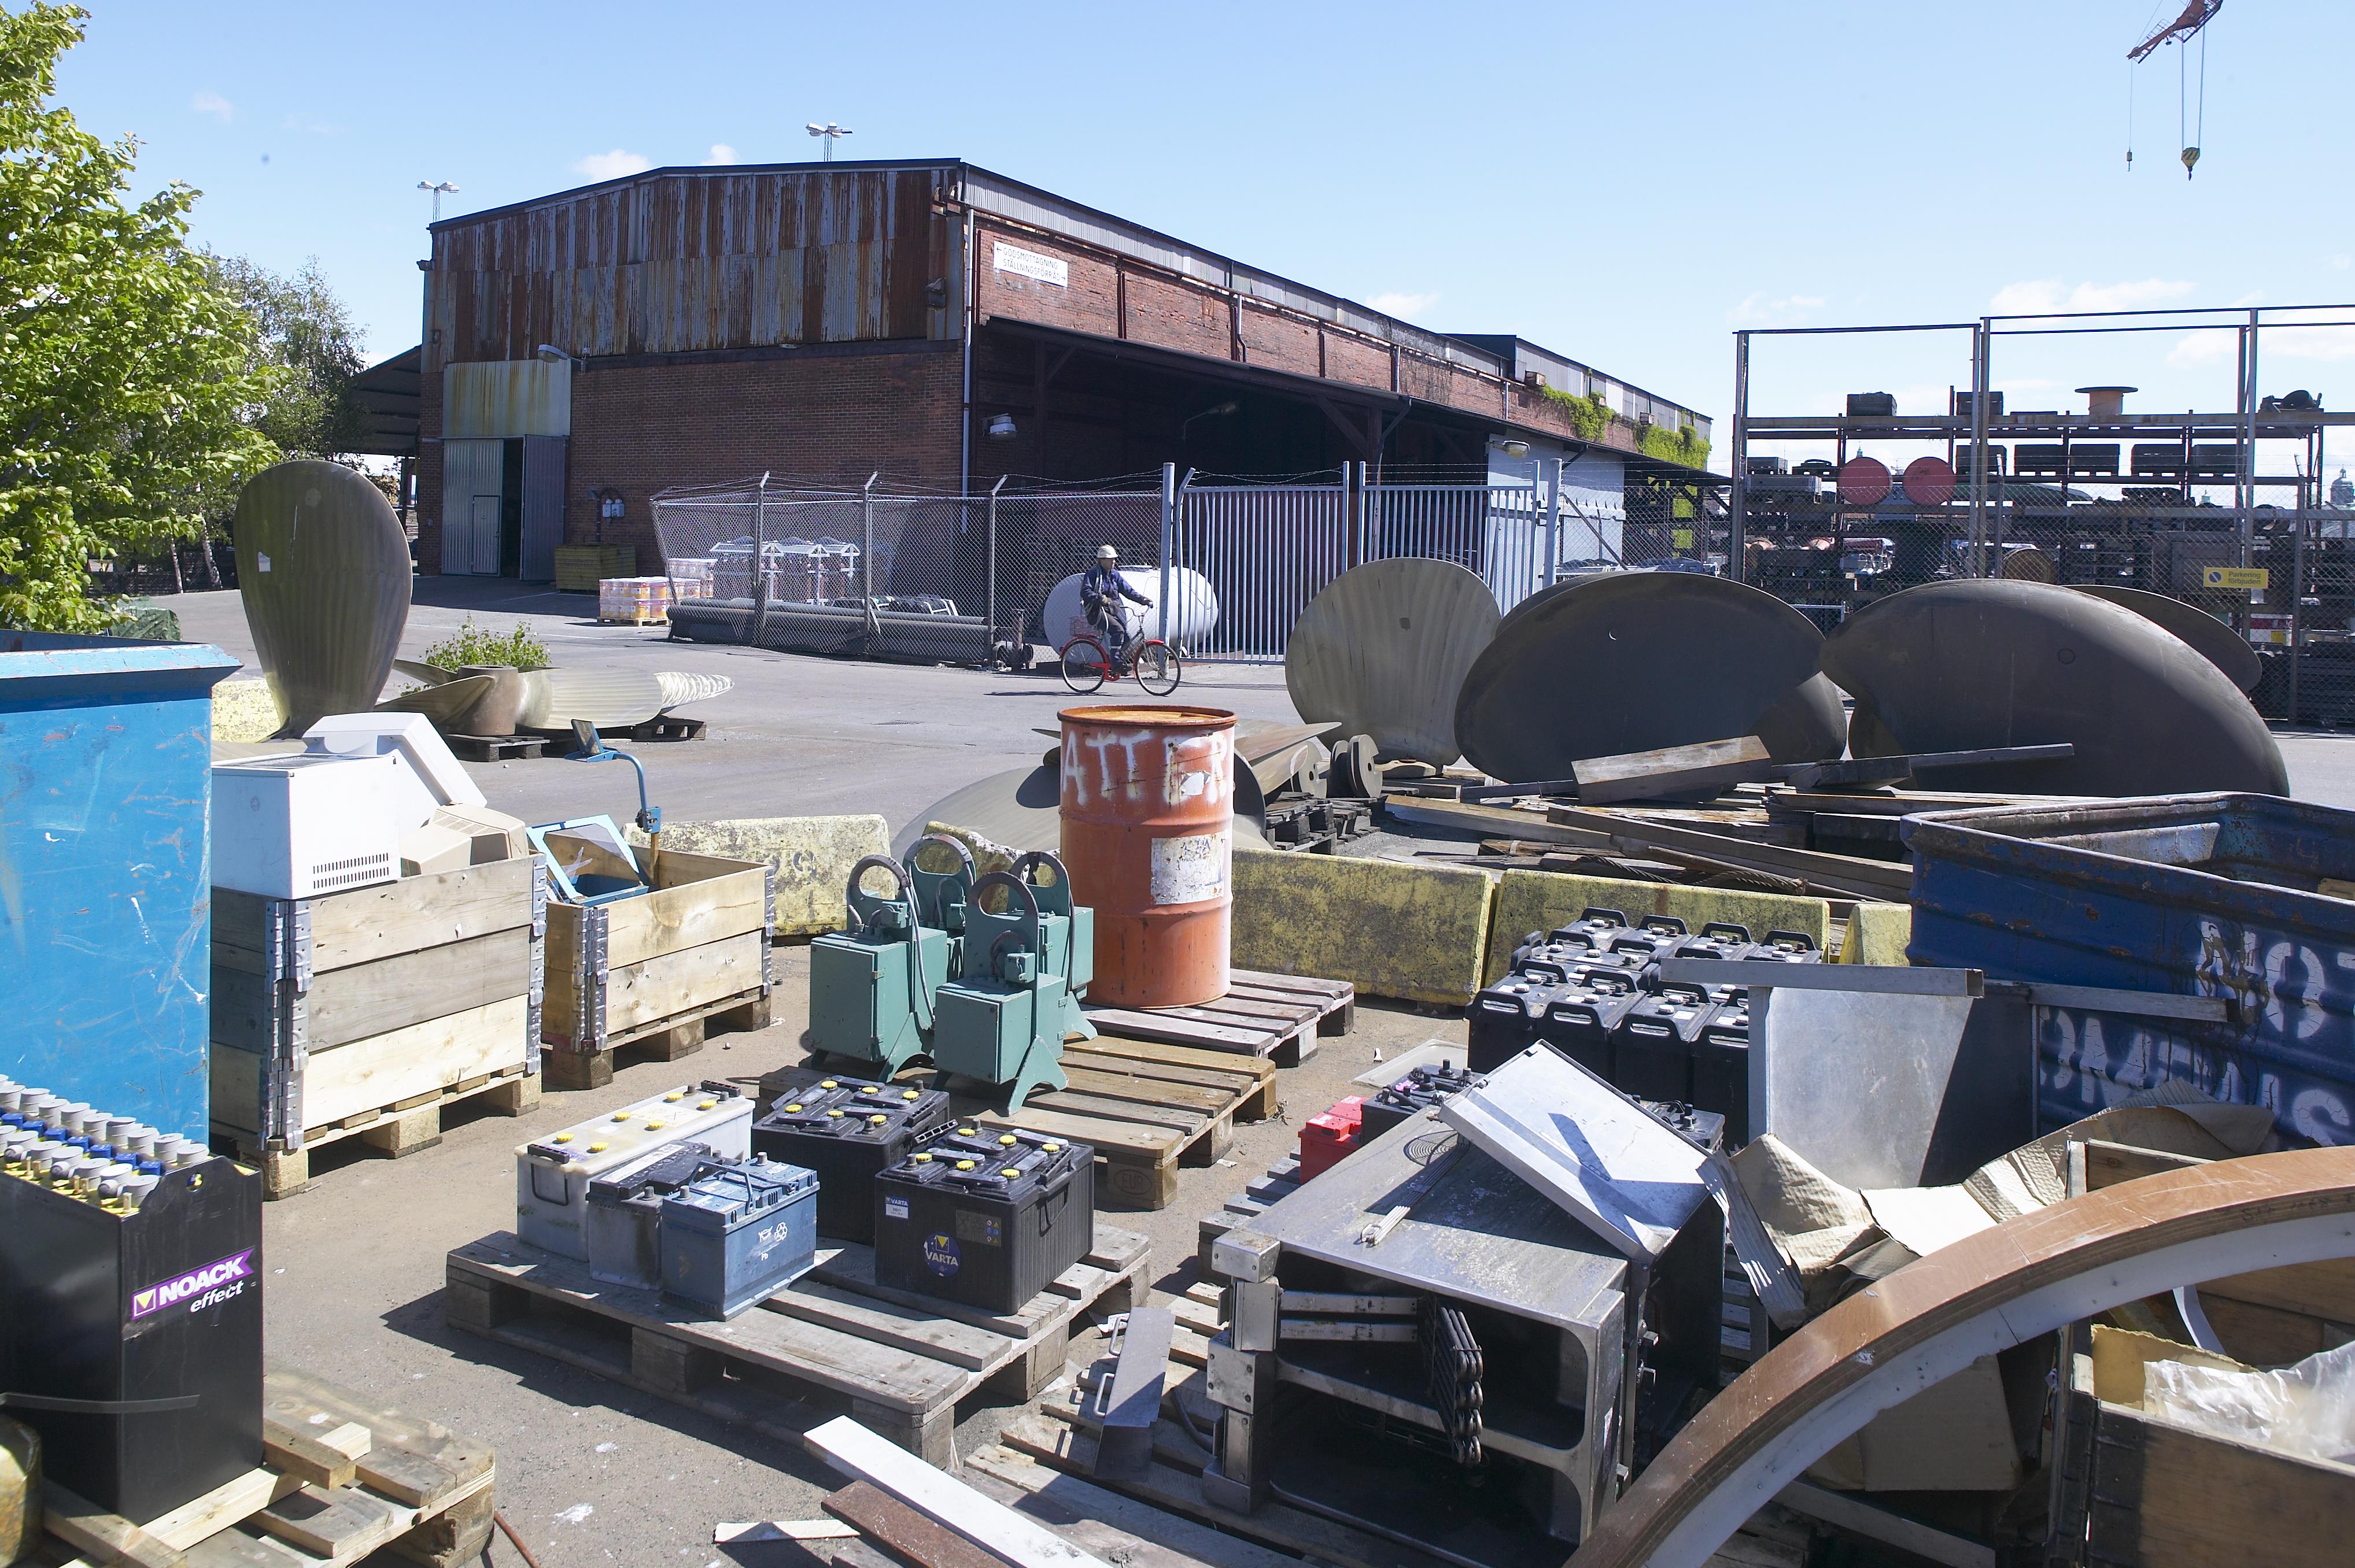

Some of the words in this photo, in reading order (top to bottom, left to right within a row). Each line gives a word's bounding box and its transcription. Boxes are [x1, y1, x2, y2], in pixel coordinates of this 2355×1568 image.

[1003, 247, 1058, 270] GODSMOTTAGNING
[1003, 258, 1060, 282] STÄLLNINGSFÖRRÅD
[2228, 571, 2261, 579] Parkering
[1121, 1173, 1143, 1191] EUR
[891, 1198, 908, 1206] VARTA
[925, 1251, 958, 1266] VARTA
[159, 1256, 245, 1306] NOACK
[190, 1279, 245, 1313] effect
